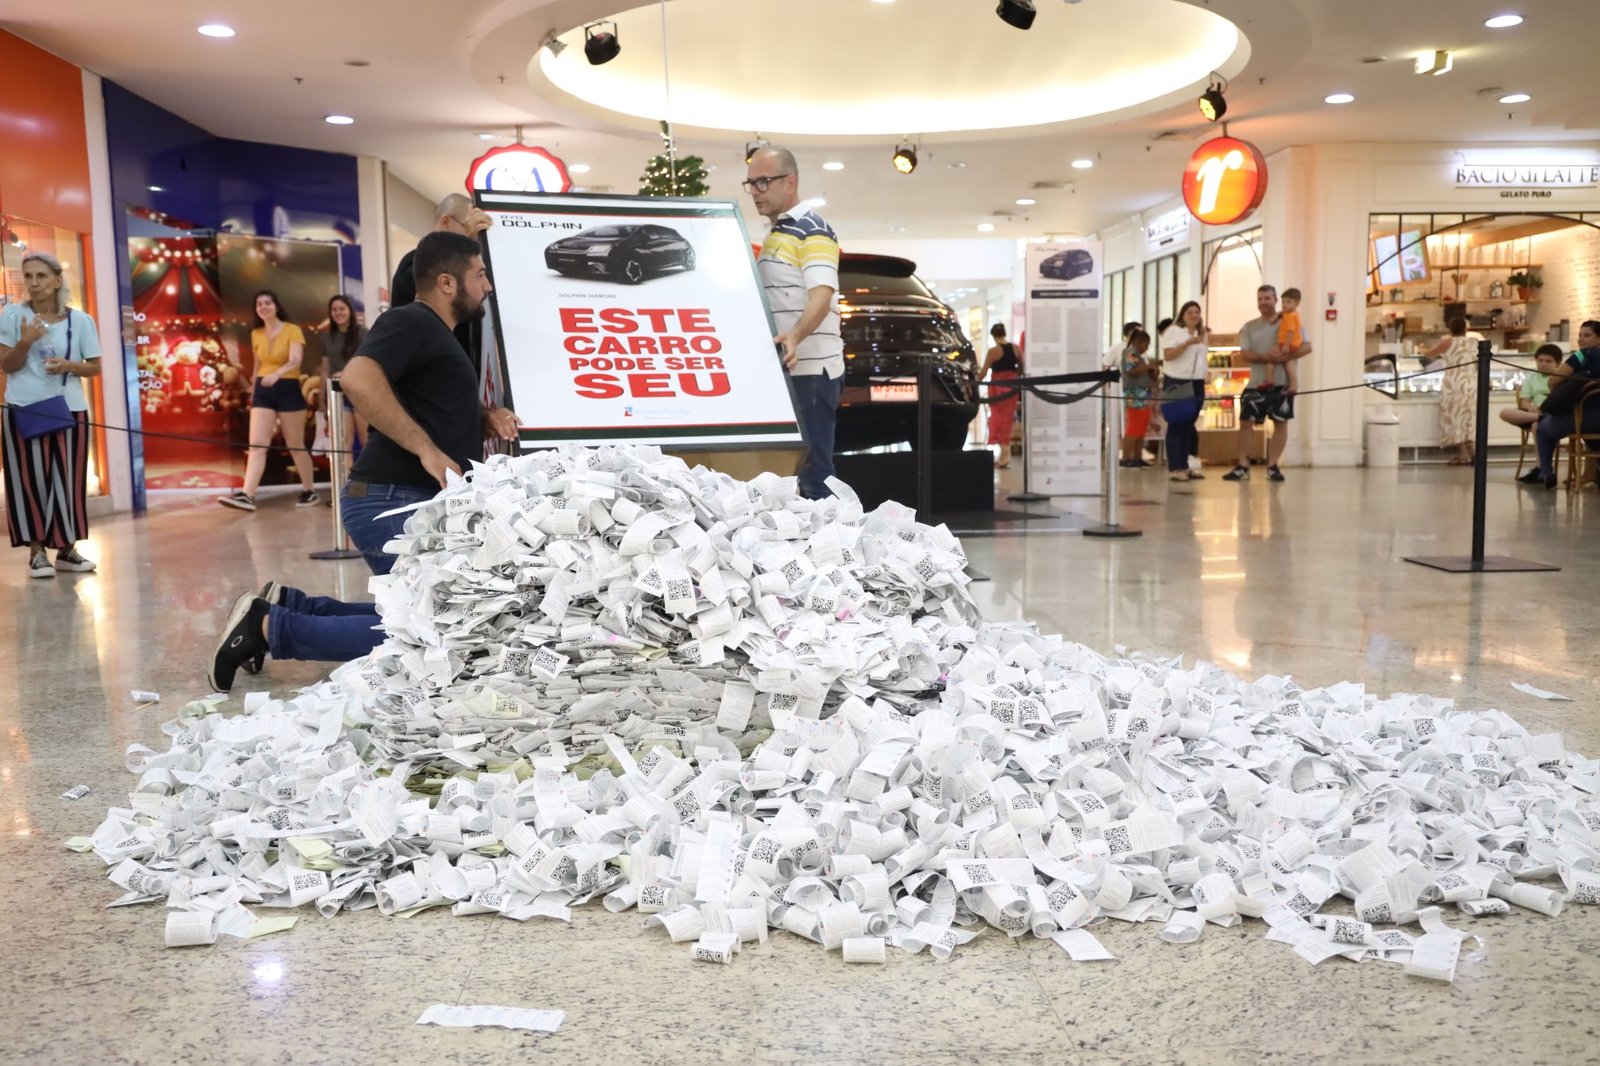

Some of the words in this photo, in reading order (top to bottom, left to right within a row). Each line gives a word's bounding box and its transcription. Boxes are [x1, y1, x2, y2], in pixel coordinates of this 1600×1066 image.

[1456, 168, 1517, 184] BACIO
[1543, 167, 1600, 184] LATTE
[1499, 190, 1530, 199] GELATO
[1531, 190, 1553, 199] PURO
[501, 219, 583, 230] DOLPHIN
[558, 307, 717, 334] ESTE
[563, 335, 722, 356] CARRO
[568, 356, 657, 371] PODE
[663, 356, 726, 371] SER
[573, 371, 732, 400] SEU
